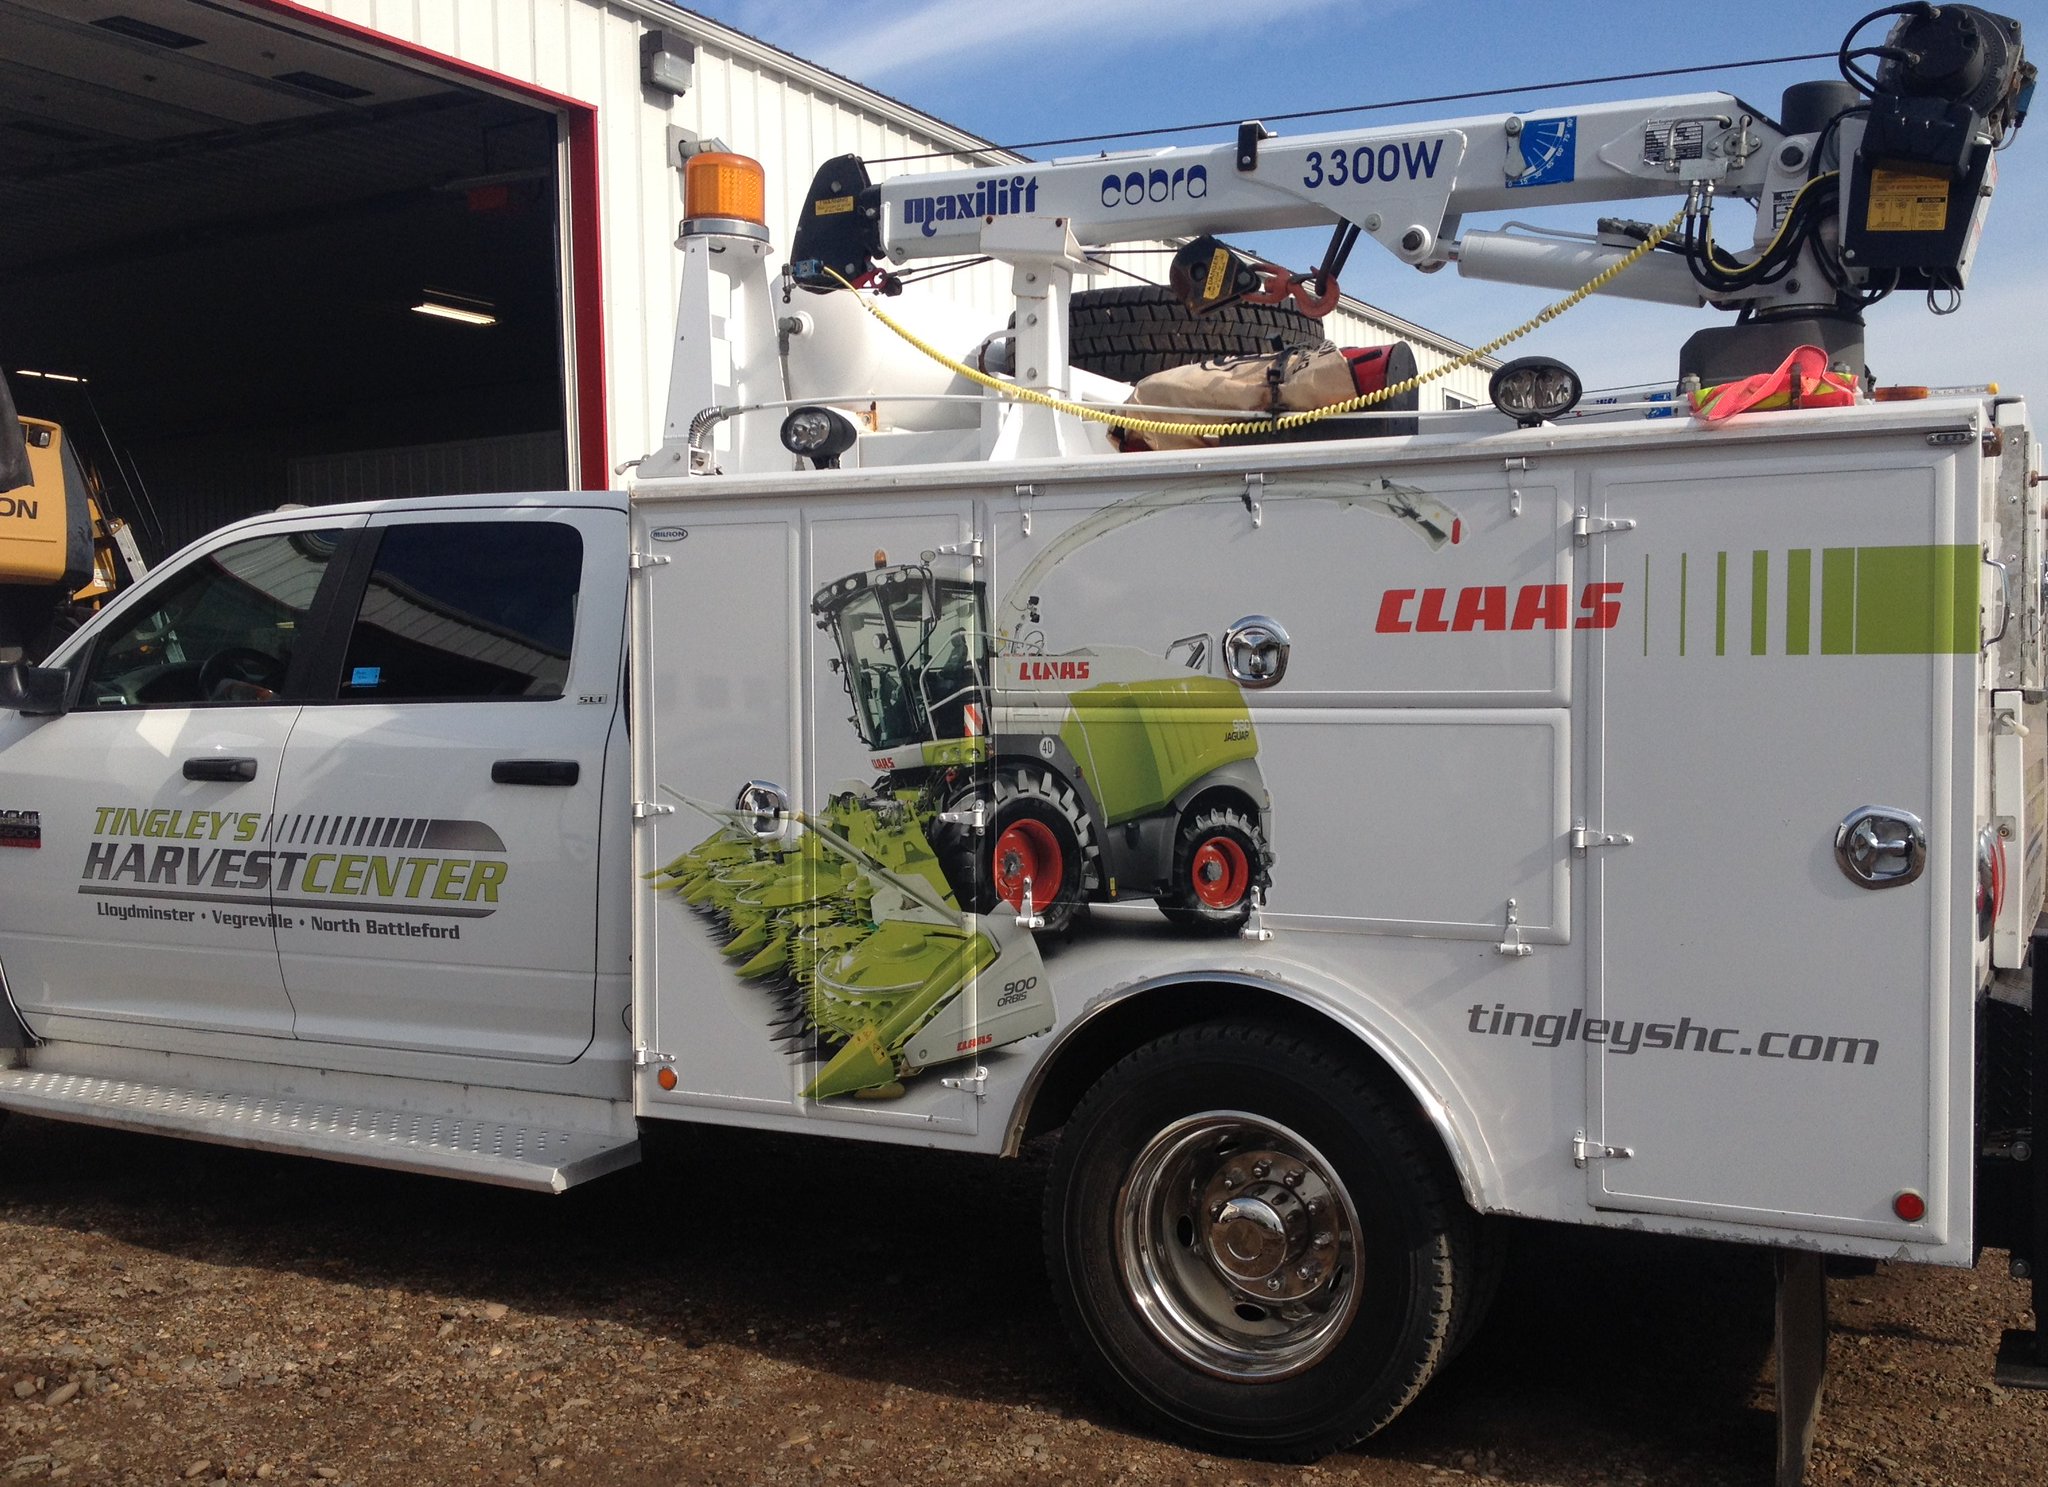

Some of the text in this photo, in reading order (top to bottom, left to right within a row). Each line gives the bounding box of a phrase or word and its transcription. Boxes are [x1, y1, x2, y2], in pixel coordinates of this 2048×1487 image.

[903, 139, 1444, 237] maxilift cobra 3300W
[1375, 582, 1624, 633] CLAAS
[1042, 741, 1053, 754] 40
[94, 807, 262, 842] TINGLEY'S
[81, 842, 508, 903] HARVESTCENTER
[97, 902, 460, 940] Lloydminster Vegreville North Battleford
[997, 991, 1028, 1007] ORBIS
[1004, 976, 1037, 996] 900
[1467, 1004, 1880, 1065] tingleyshc.com
